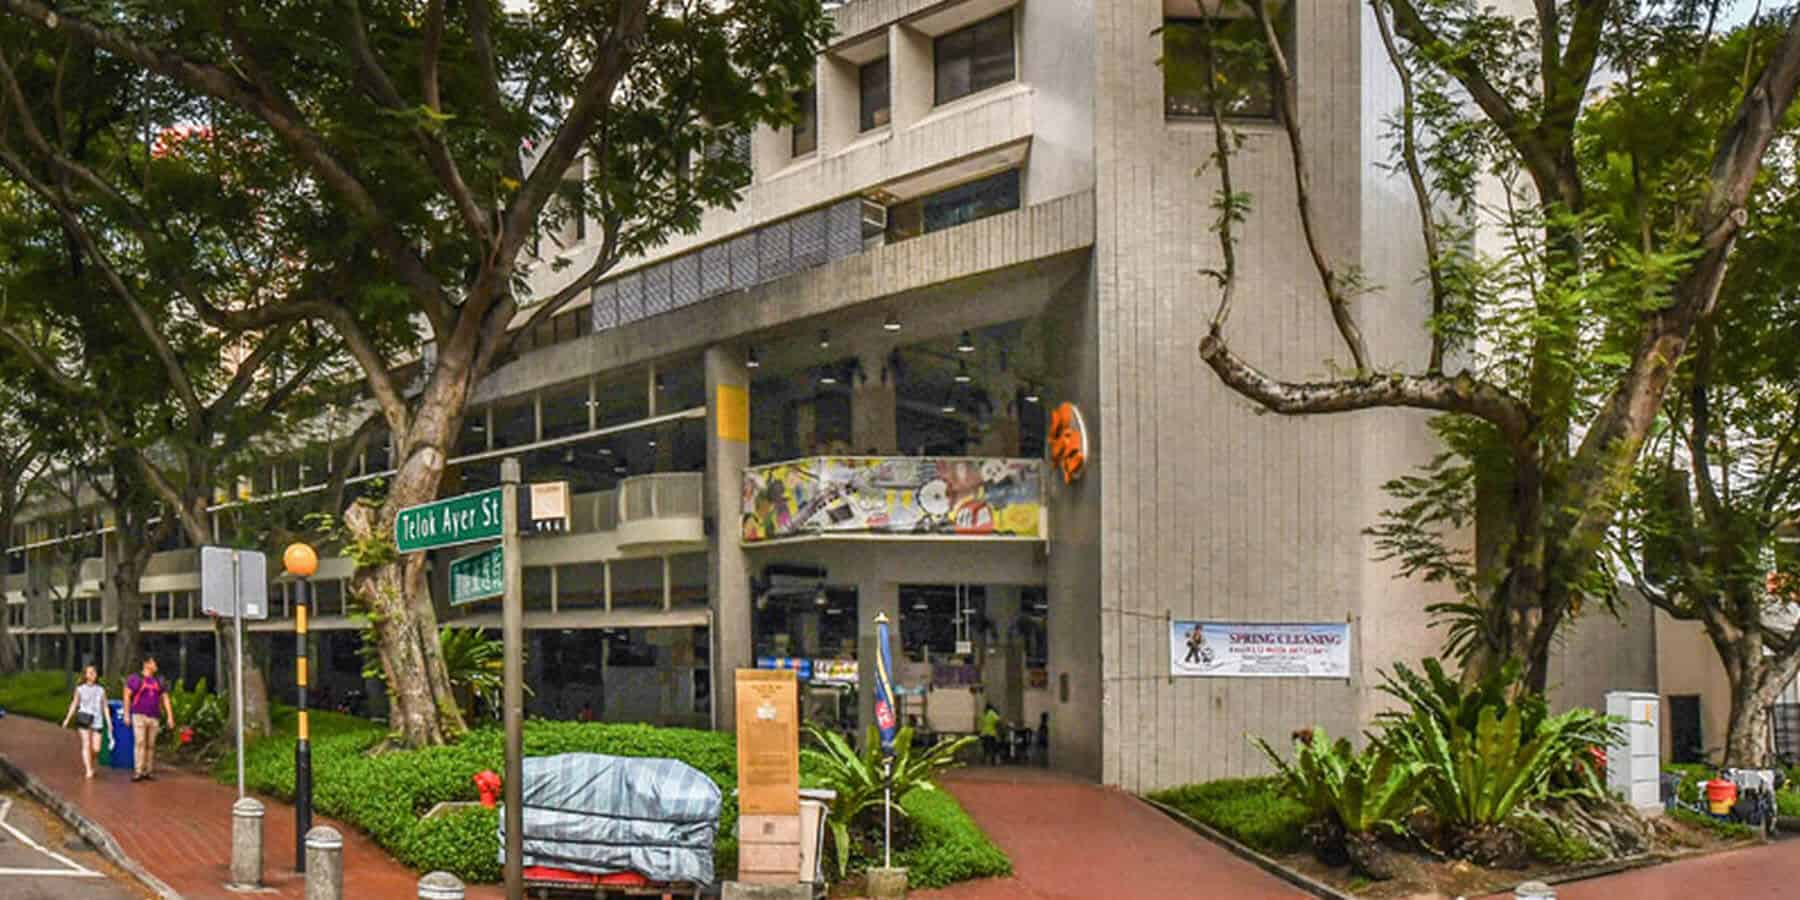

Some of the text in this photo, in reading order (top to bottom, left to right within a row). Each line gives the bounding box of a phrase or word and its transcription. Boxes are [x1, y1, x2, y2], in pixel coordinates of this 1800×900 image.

[402, 497, 499, 541] Telok Ayer St
[1230, 632, 1342, 646] SPRING CLEANING
